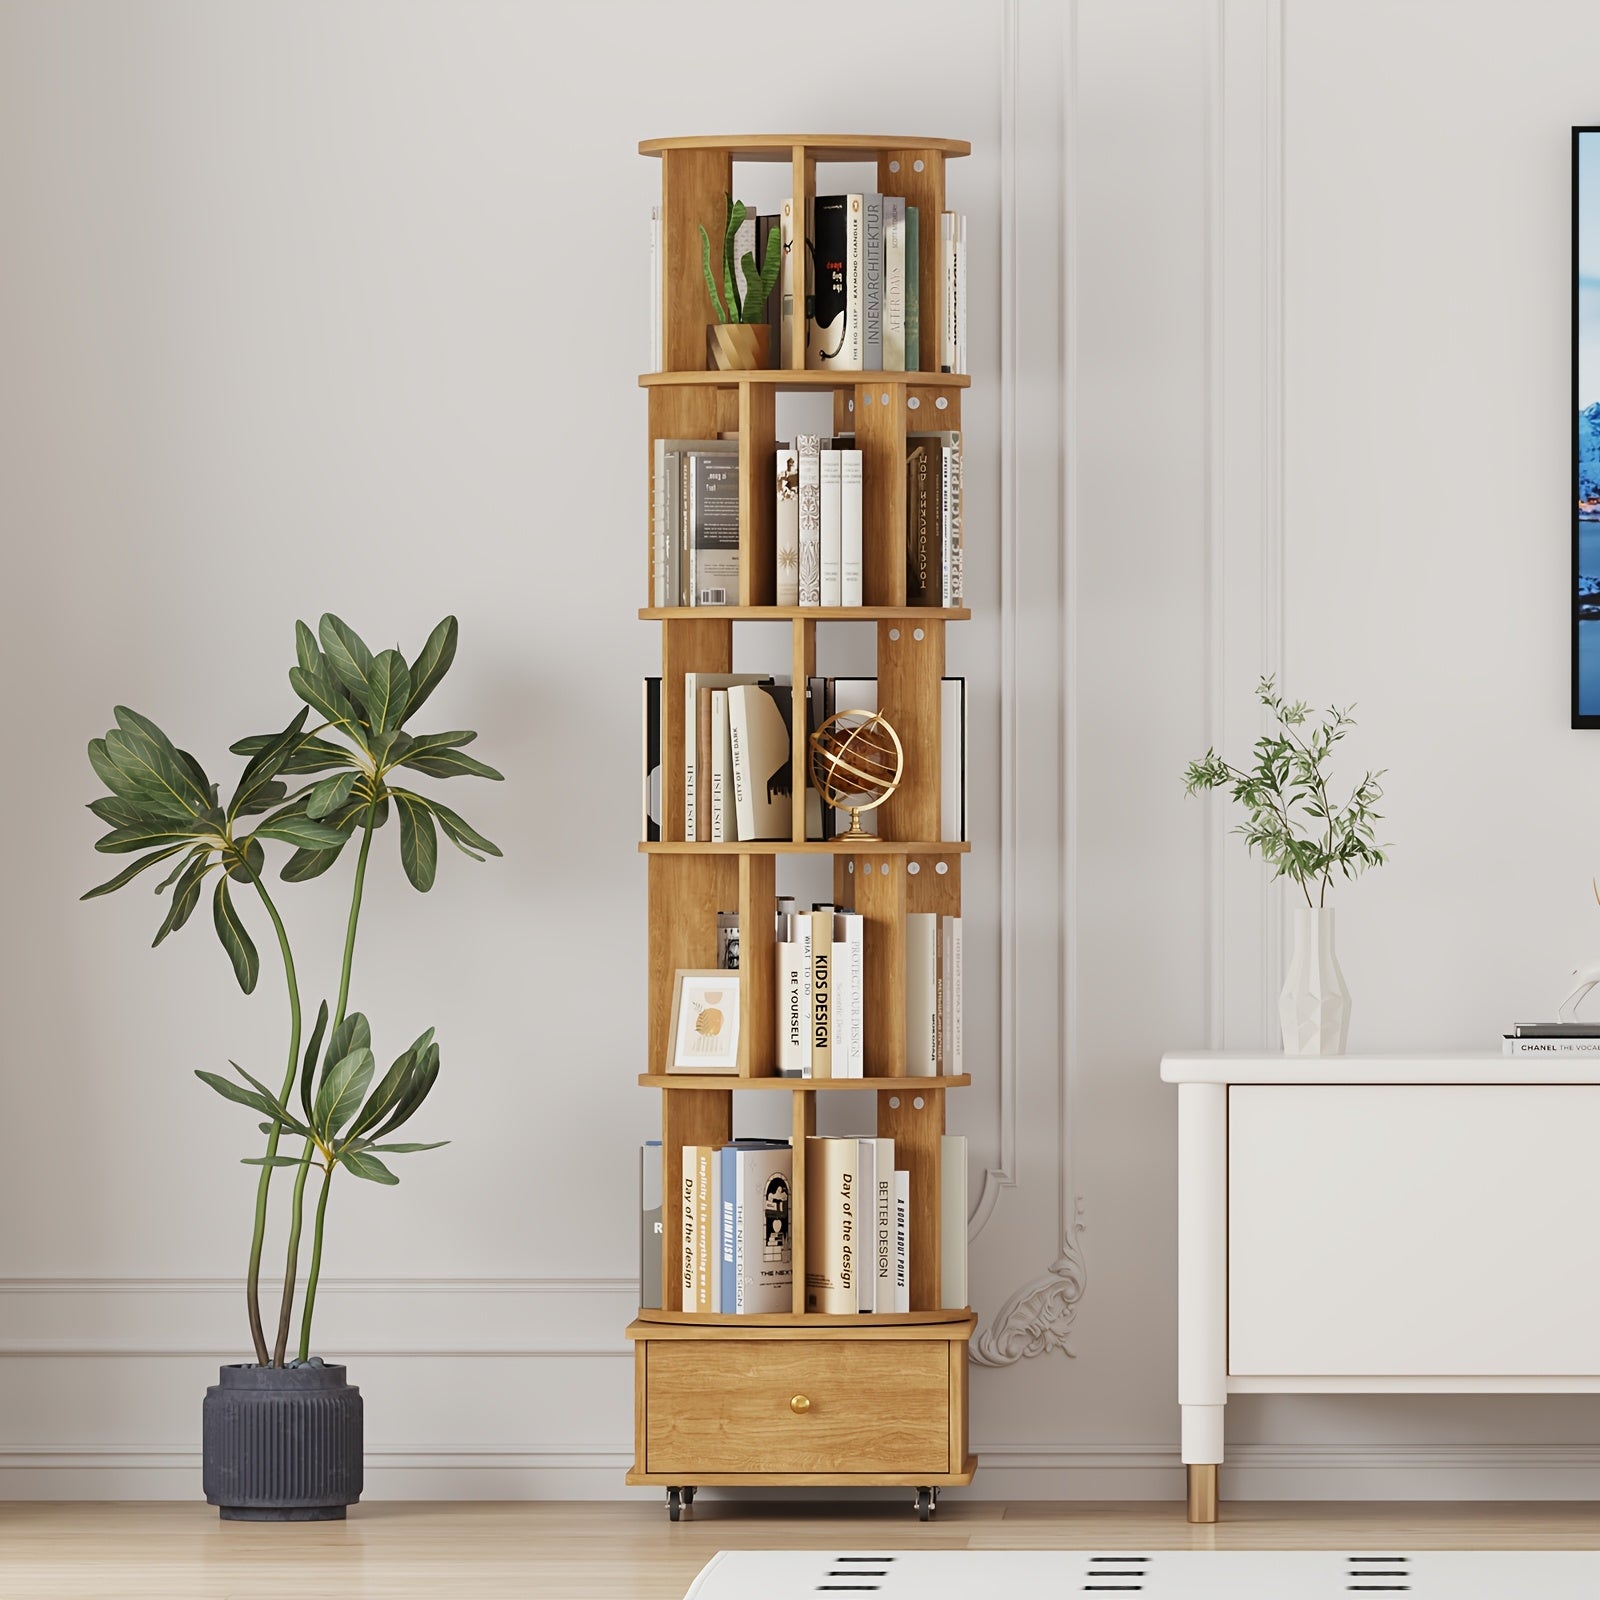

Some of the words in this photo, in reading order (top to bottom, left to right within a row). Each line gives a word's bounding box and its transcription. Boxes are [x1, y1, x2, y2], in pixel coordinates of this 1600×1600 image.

[867, 204, 880, 345] INNENARCHITEKTUR
[890, 267, 900, 295] DAYS
[889, 299, 900, 333] AFTER
[736, 771, 741, 781] OF
[790, 971, 799, 985] BE
[804, 967, 811, 978] TO
[815, 955, 828, 989] KIDS
[851, 941, 859, 989] PROTECT
[804, 983, 811, 996] DO
[851, 991, 859, 1016] OUR
[790, 989, 799, 1047] YOURSELF
[815, 993, 828, 1048] DESIGN
[851, 1018, 859, 1058] DESIGN
[684, 1179, 694, 1203] Day
[699, 1157, 707, 1200] simplicity
[841, 1173, 853, 1199] Day
[684, 1206, 694, 1220] of
[841, 1202, 853, 1217] of
[879, 1181, 889, 1226] BETTER
[897, 1207, 905, 1228] BOOK
[685, 1223, 693, 1243] the
[723, 1201, 734, 1263] MINIMALISM
[842, 1220, 853, 1242] the
[897, 1231, 905, 1256] ABOUT
[698, 1225, 707, 1272] everything
[879, 1230, 889, 1278] DESIGN
[684, 1247, 694, 1289] design
[841, 1245, 853, 1289] design
[897, 1259, 905, 1287] POINTS
